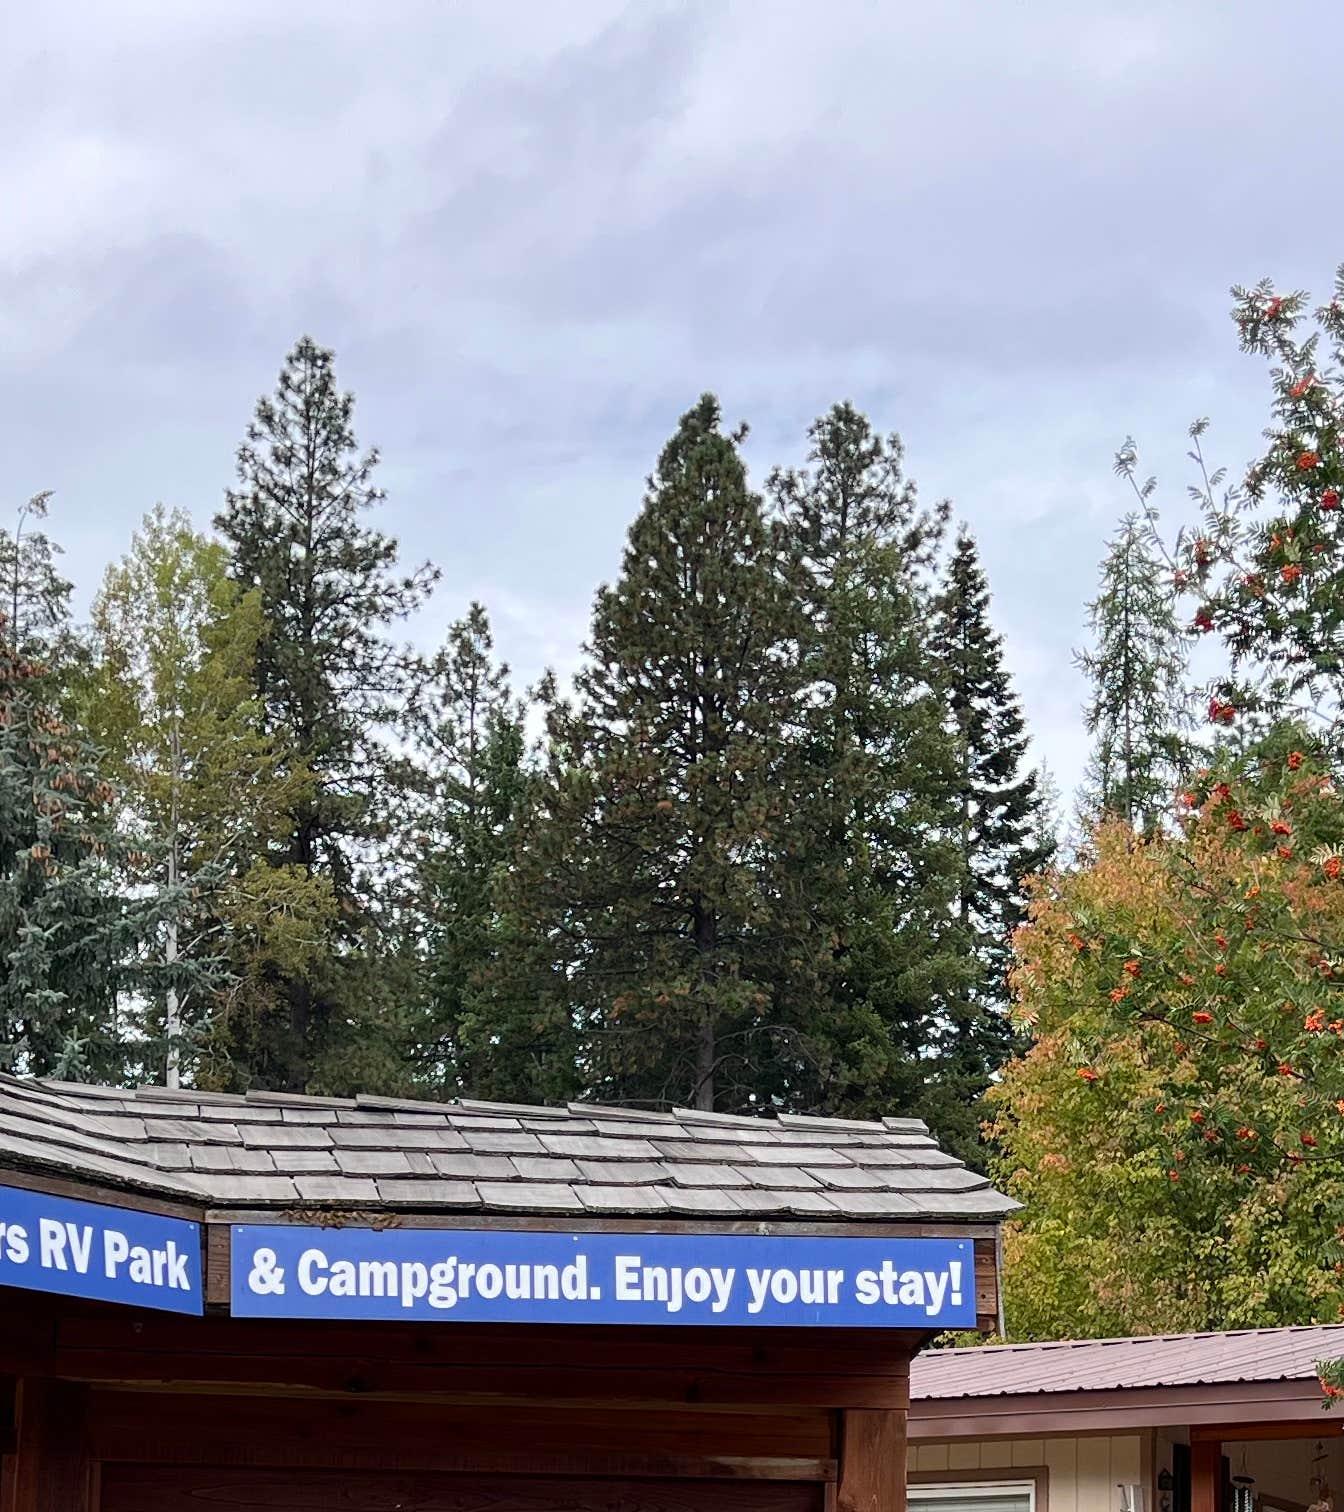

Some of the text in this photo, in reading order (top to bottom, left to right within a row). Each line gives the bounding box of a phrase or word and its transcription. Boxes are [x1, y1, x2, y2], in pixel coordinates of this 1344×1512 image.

[40, 1217, 93, 1273] RV
[104, 1228, 191, 1291] Park
[247, 1248, 963, 1315] & Campground. Enjoy your stay!
